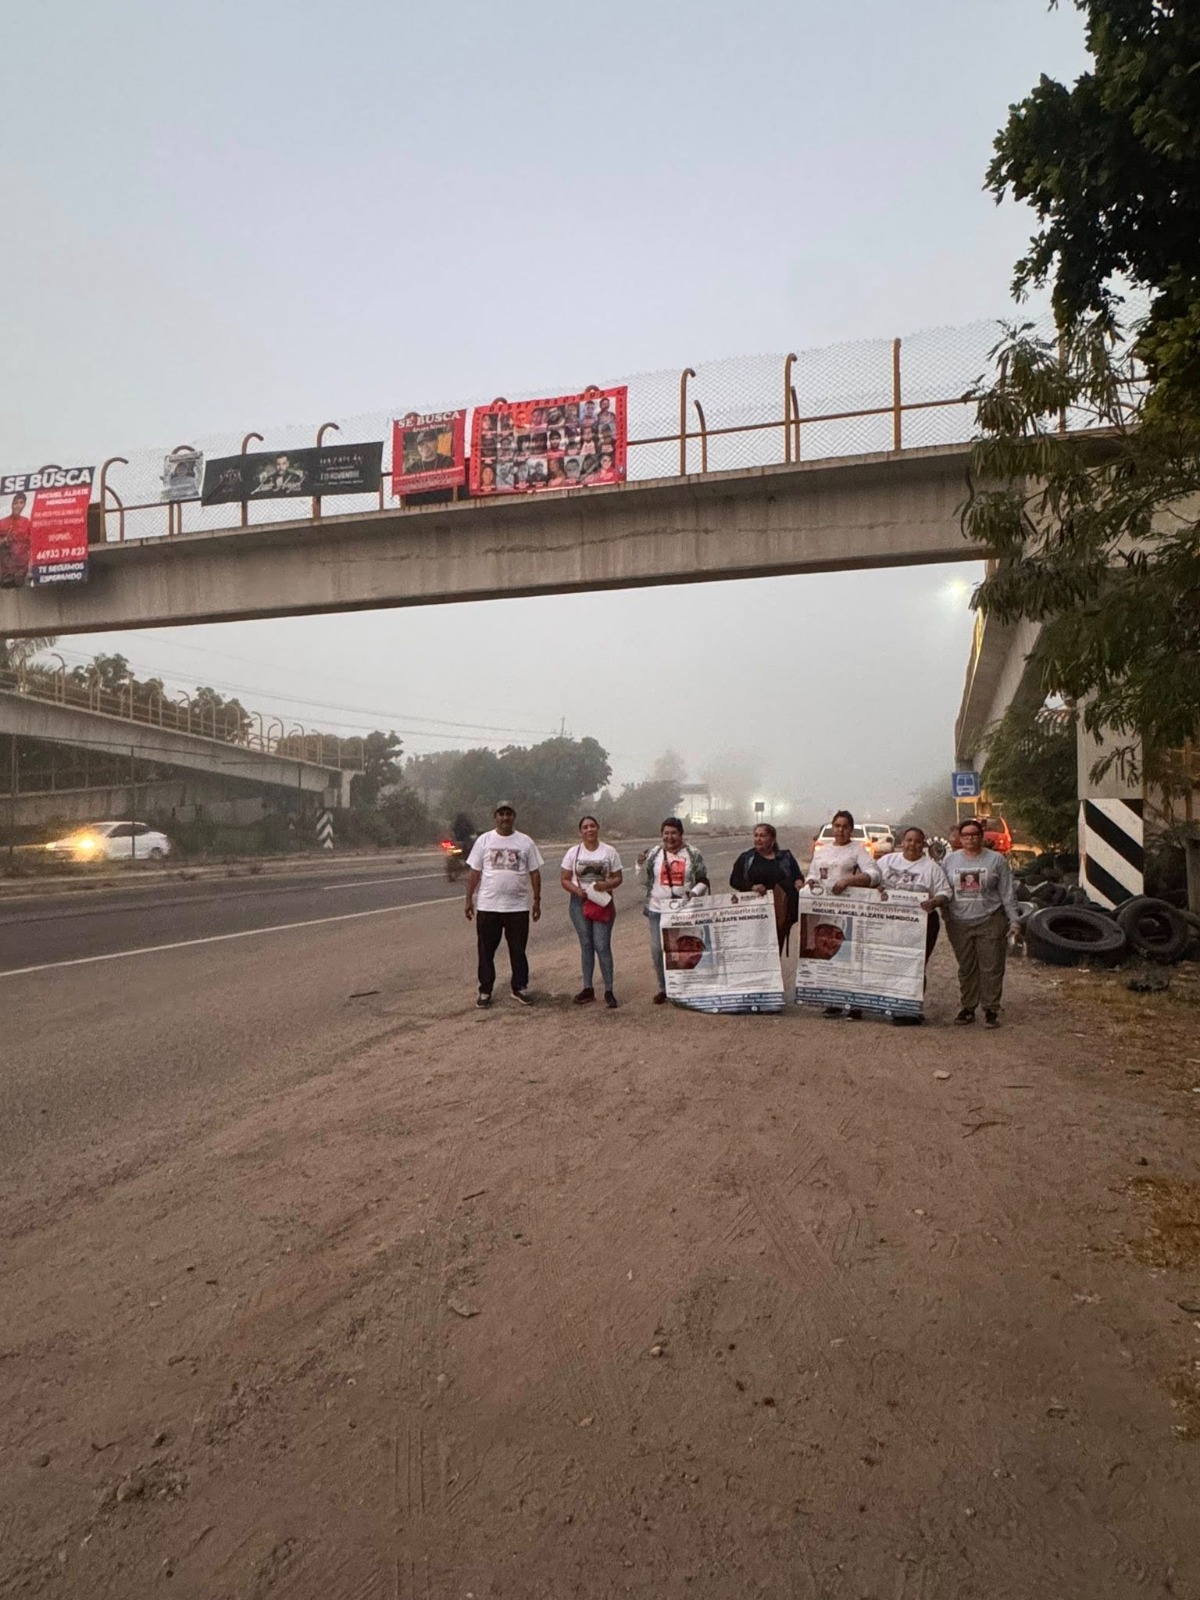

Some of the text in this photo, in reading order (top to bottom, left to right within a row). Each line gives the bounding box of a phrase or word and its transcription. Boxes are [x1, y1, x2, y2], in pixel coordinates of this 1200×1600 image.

[397, 416, 413, 429] SE
[416, 411, 461, 426] BUSCA
[4, 469, 91, 493] SE BUSCA
[38, 562, 84, 574] TE SEGUIMOS
